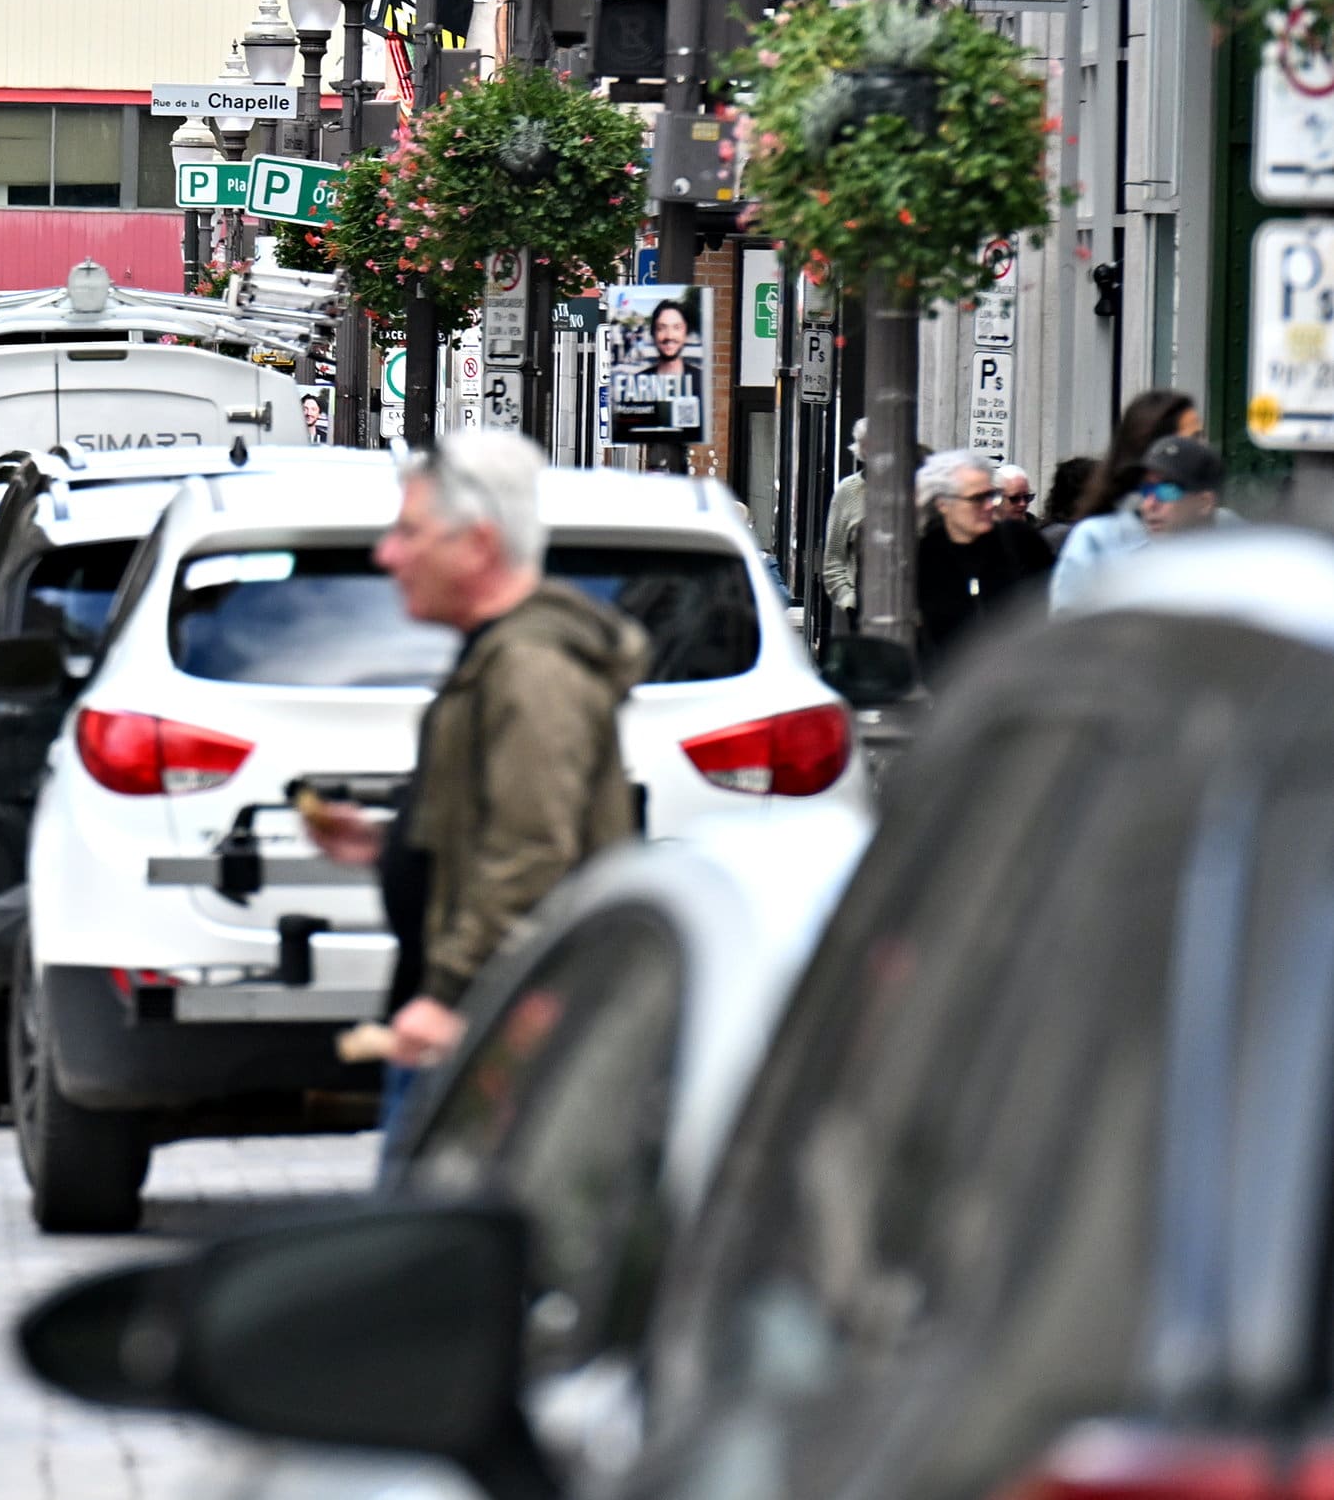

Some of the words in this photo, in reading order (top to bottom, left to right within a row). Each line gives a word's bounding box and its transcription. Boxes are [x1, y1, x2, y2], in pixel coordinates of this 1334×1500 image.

[152, 98, 171, 108] Rue
[175, 98, 187, 108] de
[191, 98, 200, 108] la
[207, 92, 290, 112] Chapelle
[189, 170, 209, 198] P
[263, 169, 290, 205] P
